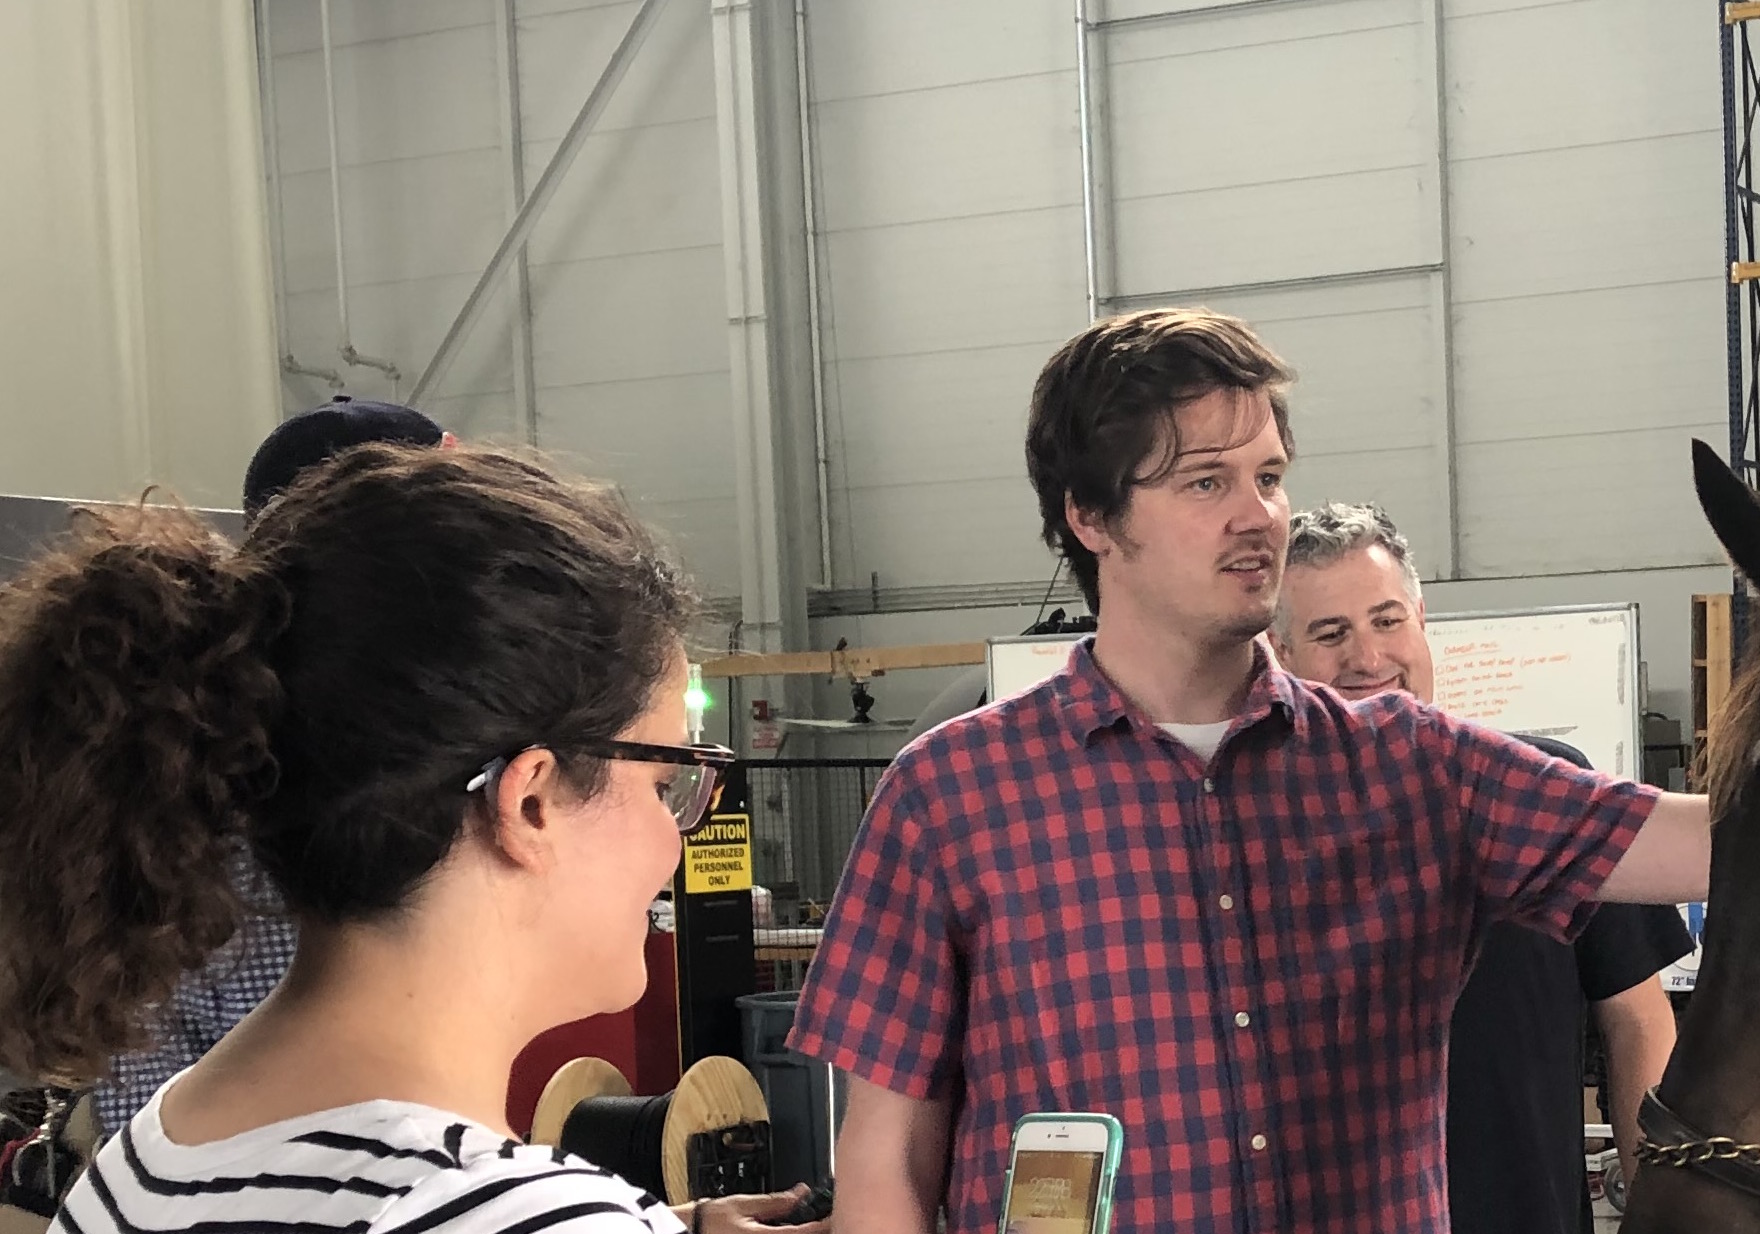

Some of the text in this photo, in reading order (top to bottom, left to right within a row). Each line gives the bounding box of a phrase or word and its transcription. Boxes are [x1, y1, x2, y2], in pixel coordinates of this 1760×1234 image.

[691, 848, 745, 859] AUTHORIZED
[694, 861, 743, 873] PERSONNEL
[708, 875, 731, 886] ONLY
